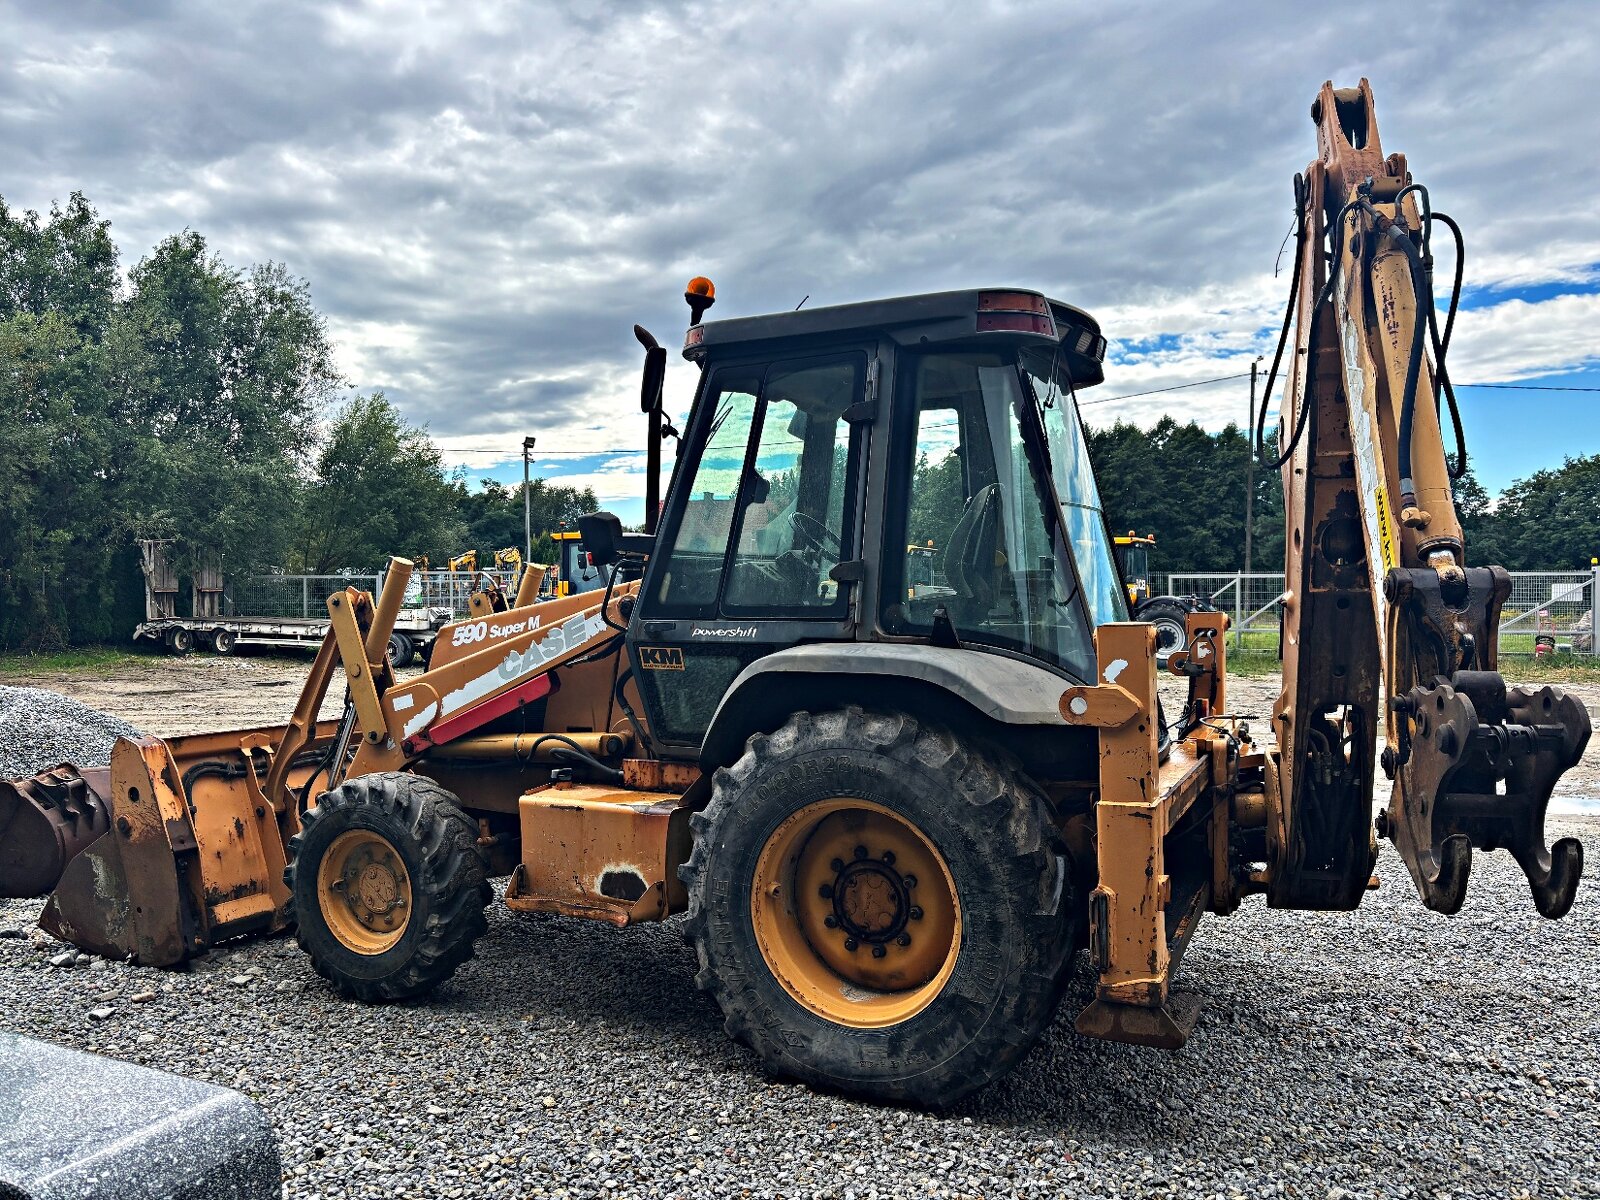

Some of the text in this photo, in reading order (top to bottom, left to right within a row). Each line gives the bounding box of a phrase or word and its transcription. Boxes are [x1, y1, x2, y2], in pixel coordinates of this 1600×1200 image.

[452, 615, 541, 647] 590 Super M
[692, 626, 758, 638] powershift
[498, 613, 588, 681] CASE
[641, 648, 682, 664] KM
